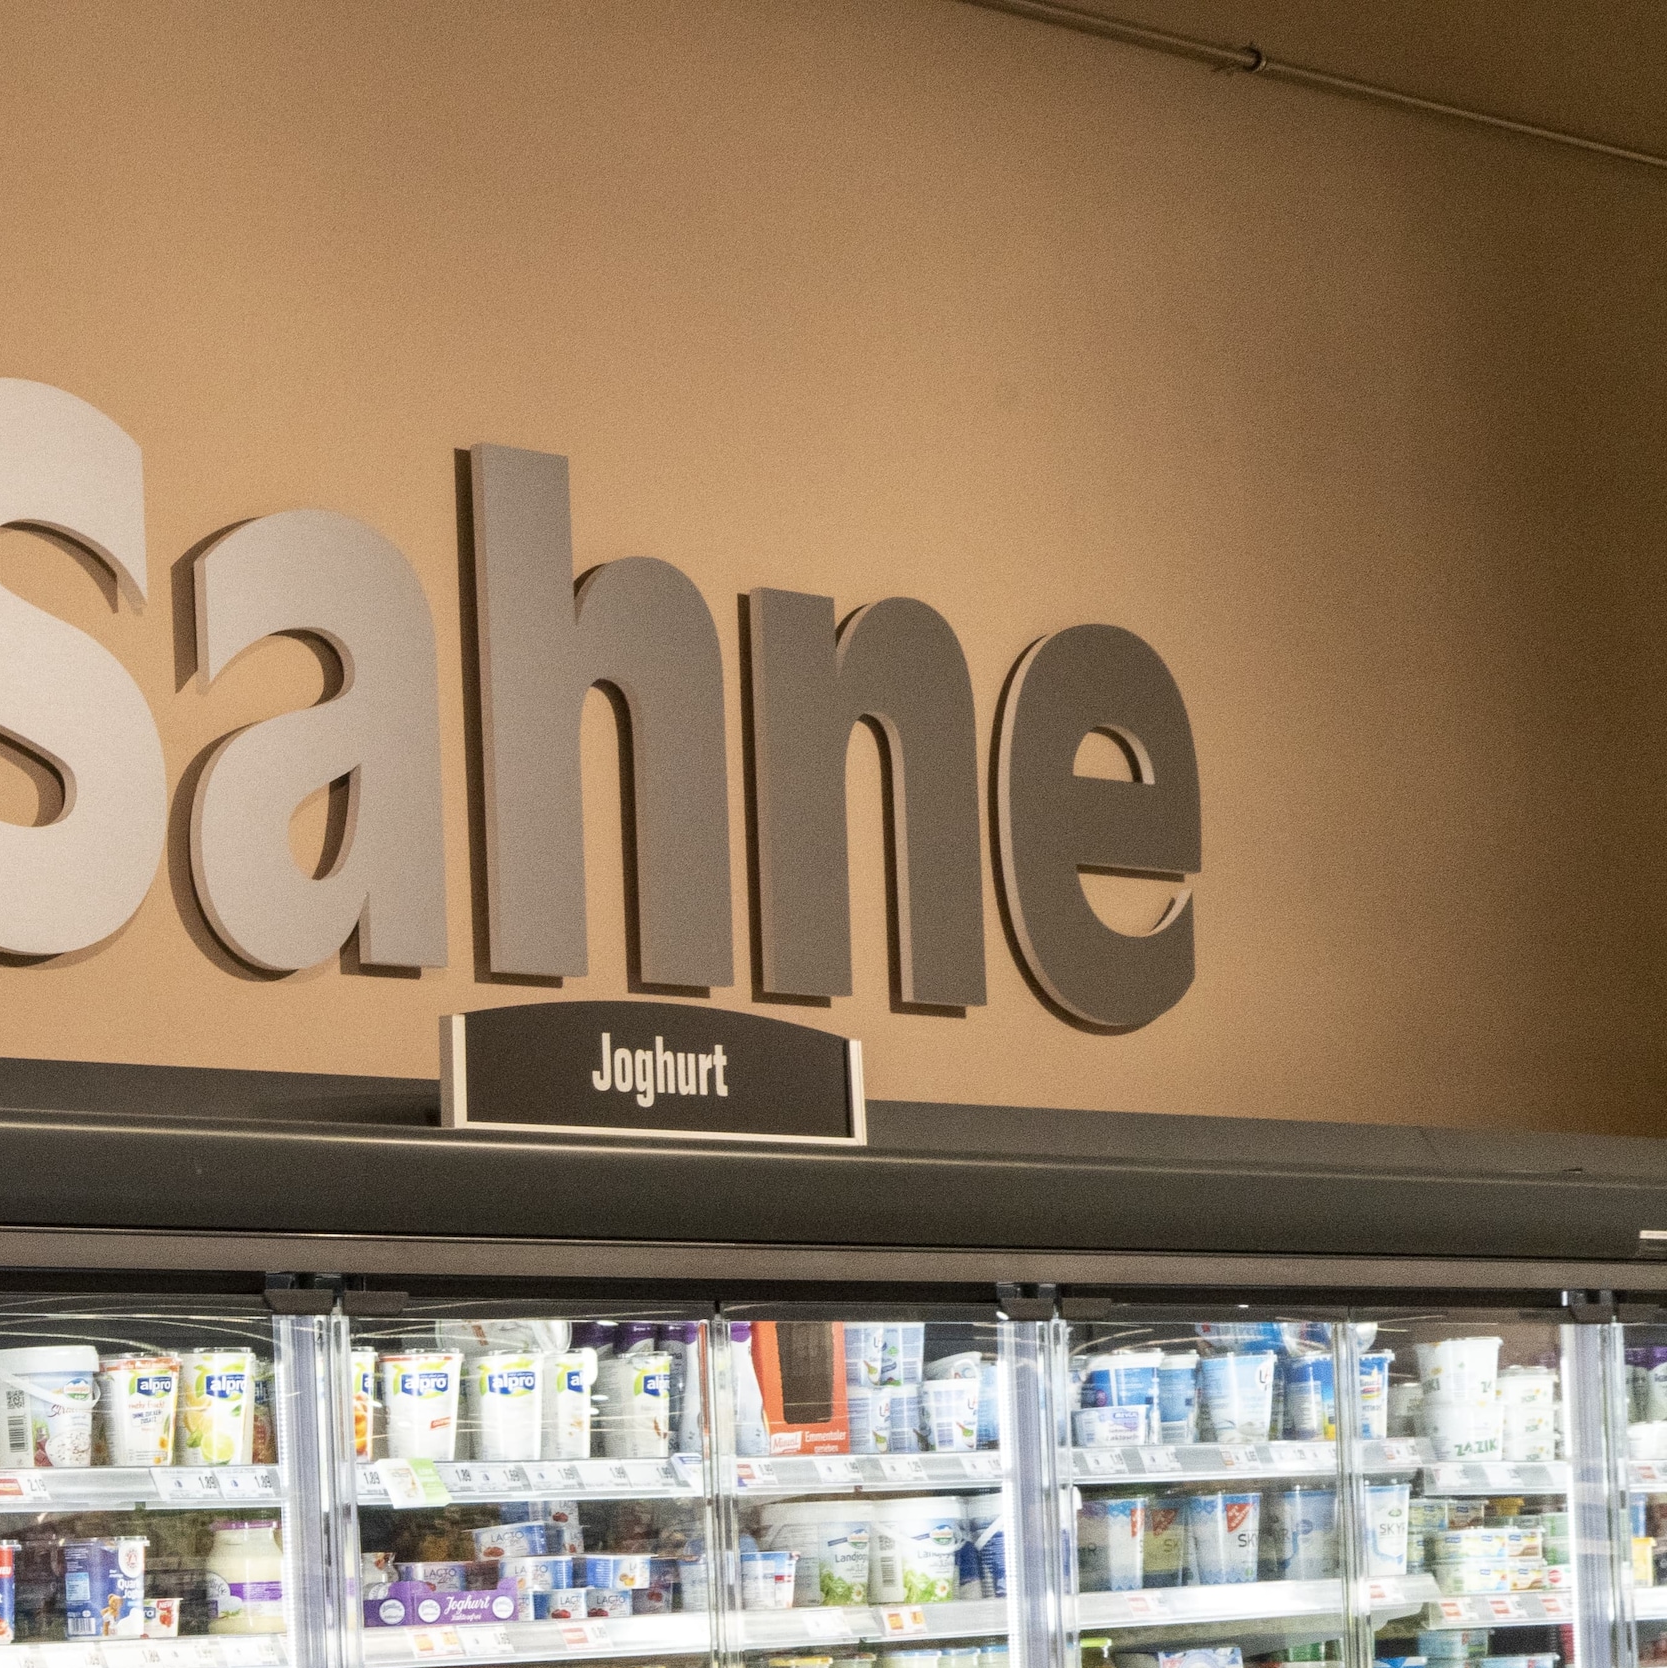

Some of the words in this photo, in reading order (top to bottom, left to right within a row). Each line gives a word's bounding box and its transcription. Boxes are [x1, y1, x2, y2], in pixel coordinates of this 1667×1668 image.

[591, 1032, 729, 1104] Joghurt
[138, 1378, 172, 1394] alpro
[403, 1375, 448, 1392] alpro
[492, 1374, 536, 1391] alpro
[443, 1592, 491, 1613] Joghurt
